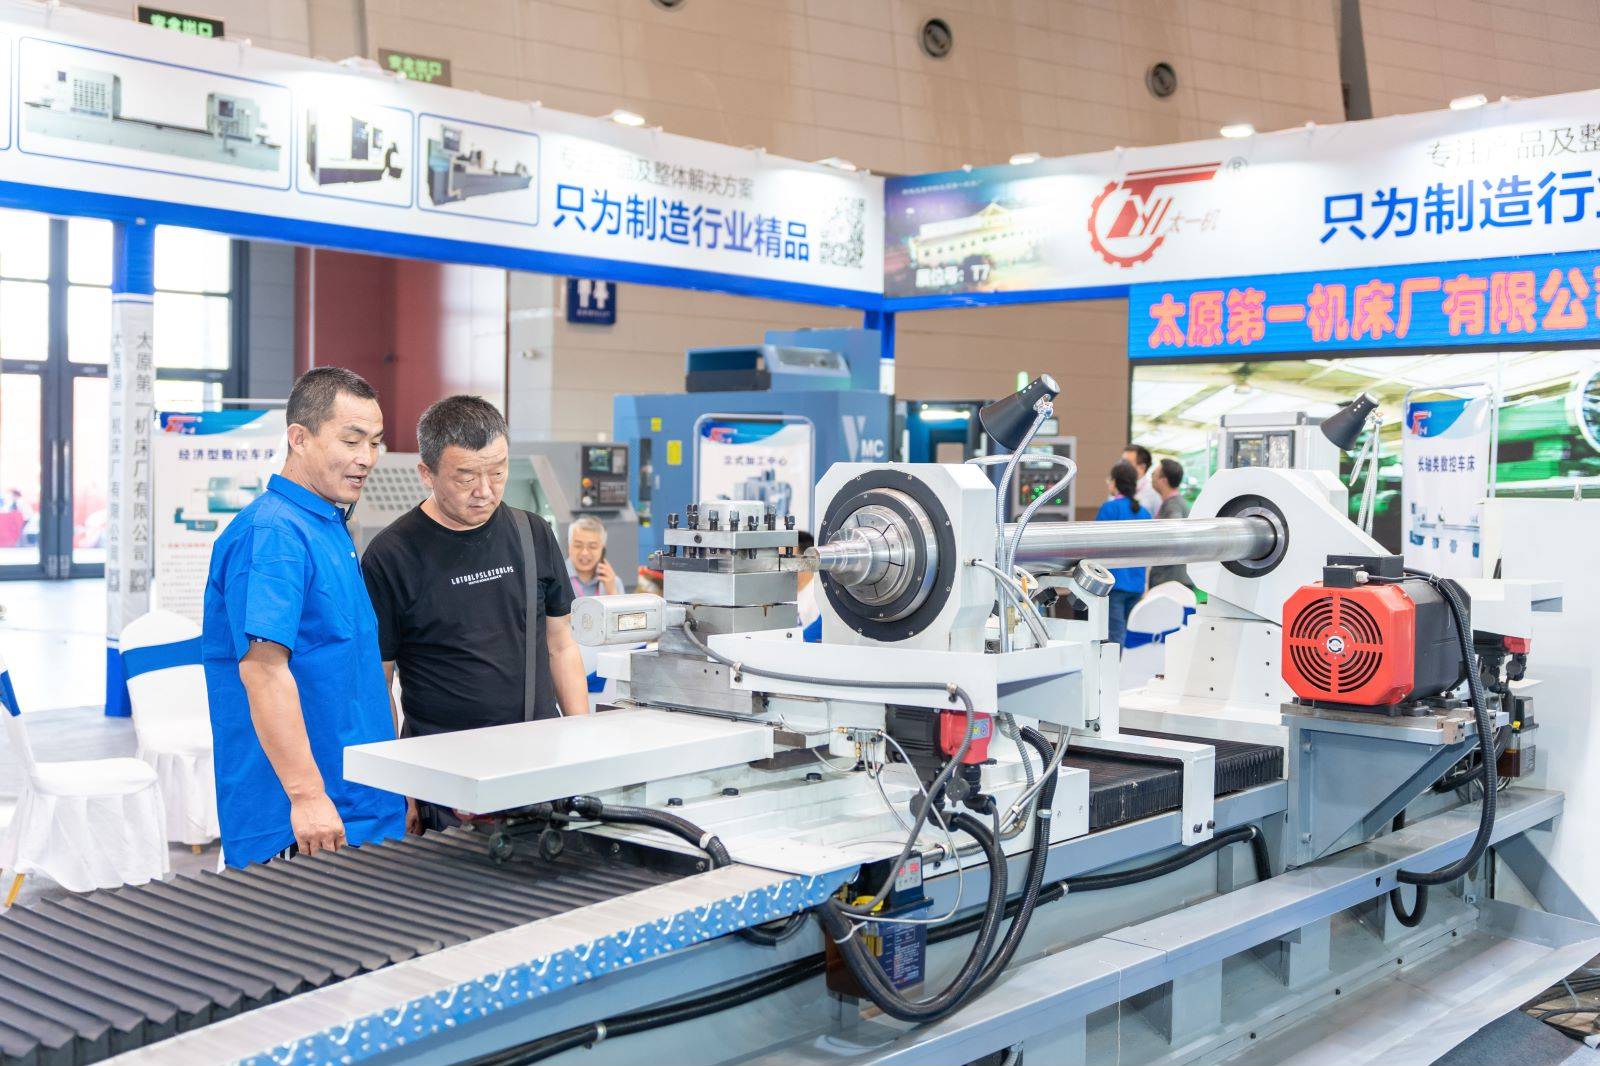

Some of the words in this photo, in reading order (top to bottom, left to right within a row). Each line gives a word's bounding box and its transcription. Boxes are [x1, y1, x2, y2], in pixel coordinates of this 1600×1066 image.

[552, 183, 810, 262] 只为制造行业精品
[1320, 170, 1600, 244] 只为制造行
[1148, 267, 1600, 349] 太原第一机床厂有限公
[131, 331, 152, 563] 太原第一机床厂有限公司
[178, 448, 275, 461] 经济型数控车床
[724, 455, 788, 466] 立式加工中心
[1417, 455, 1476, 473] 长轴类数控车床
